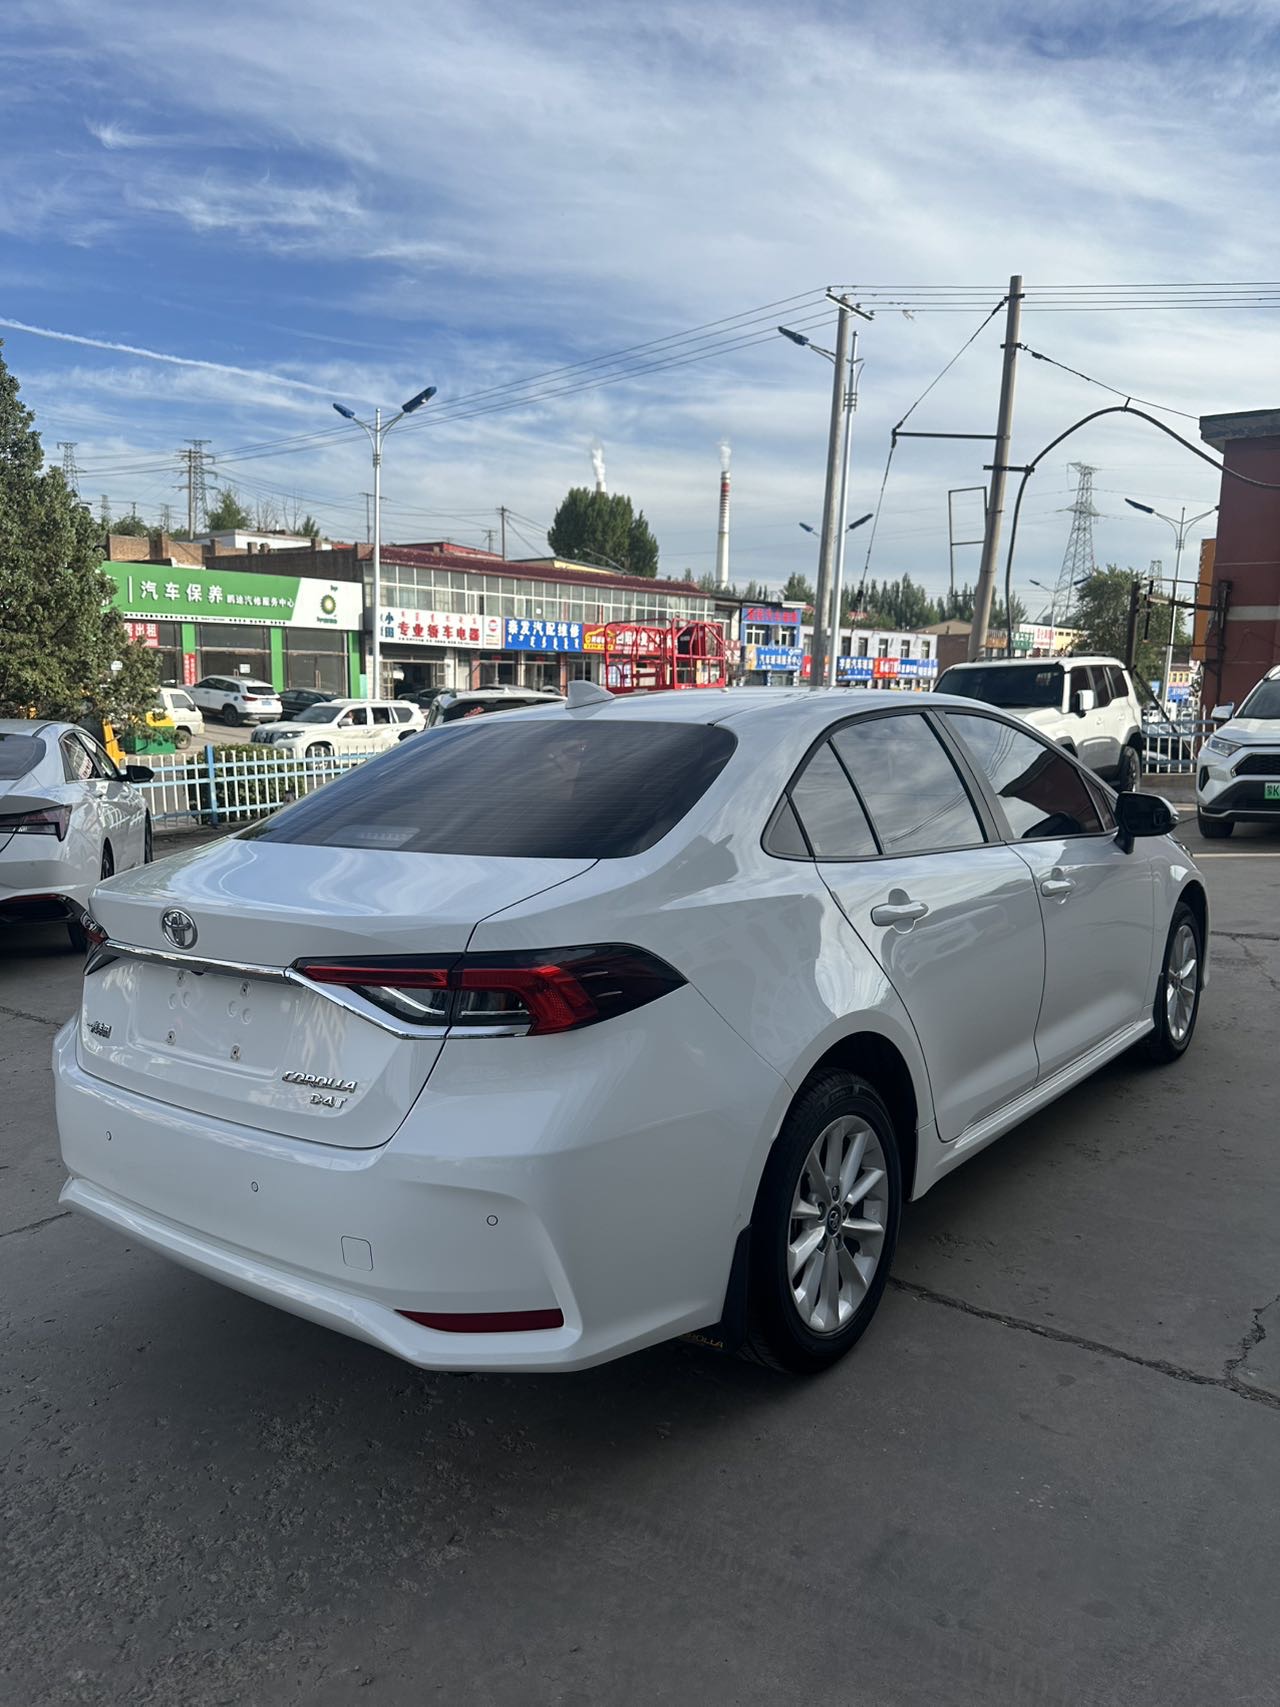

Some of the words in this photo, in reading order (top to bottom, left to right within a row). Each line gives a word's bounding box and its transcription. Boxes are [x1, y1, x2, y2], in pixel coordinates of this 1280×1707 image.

[140, 580, 223, 604] 汽车保养
[397, 621, 480, 642] 专业轿车电器
[282, 1071, 358, 1094] COROLLA
